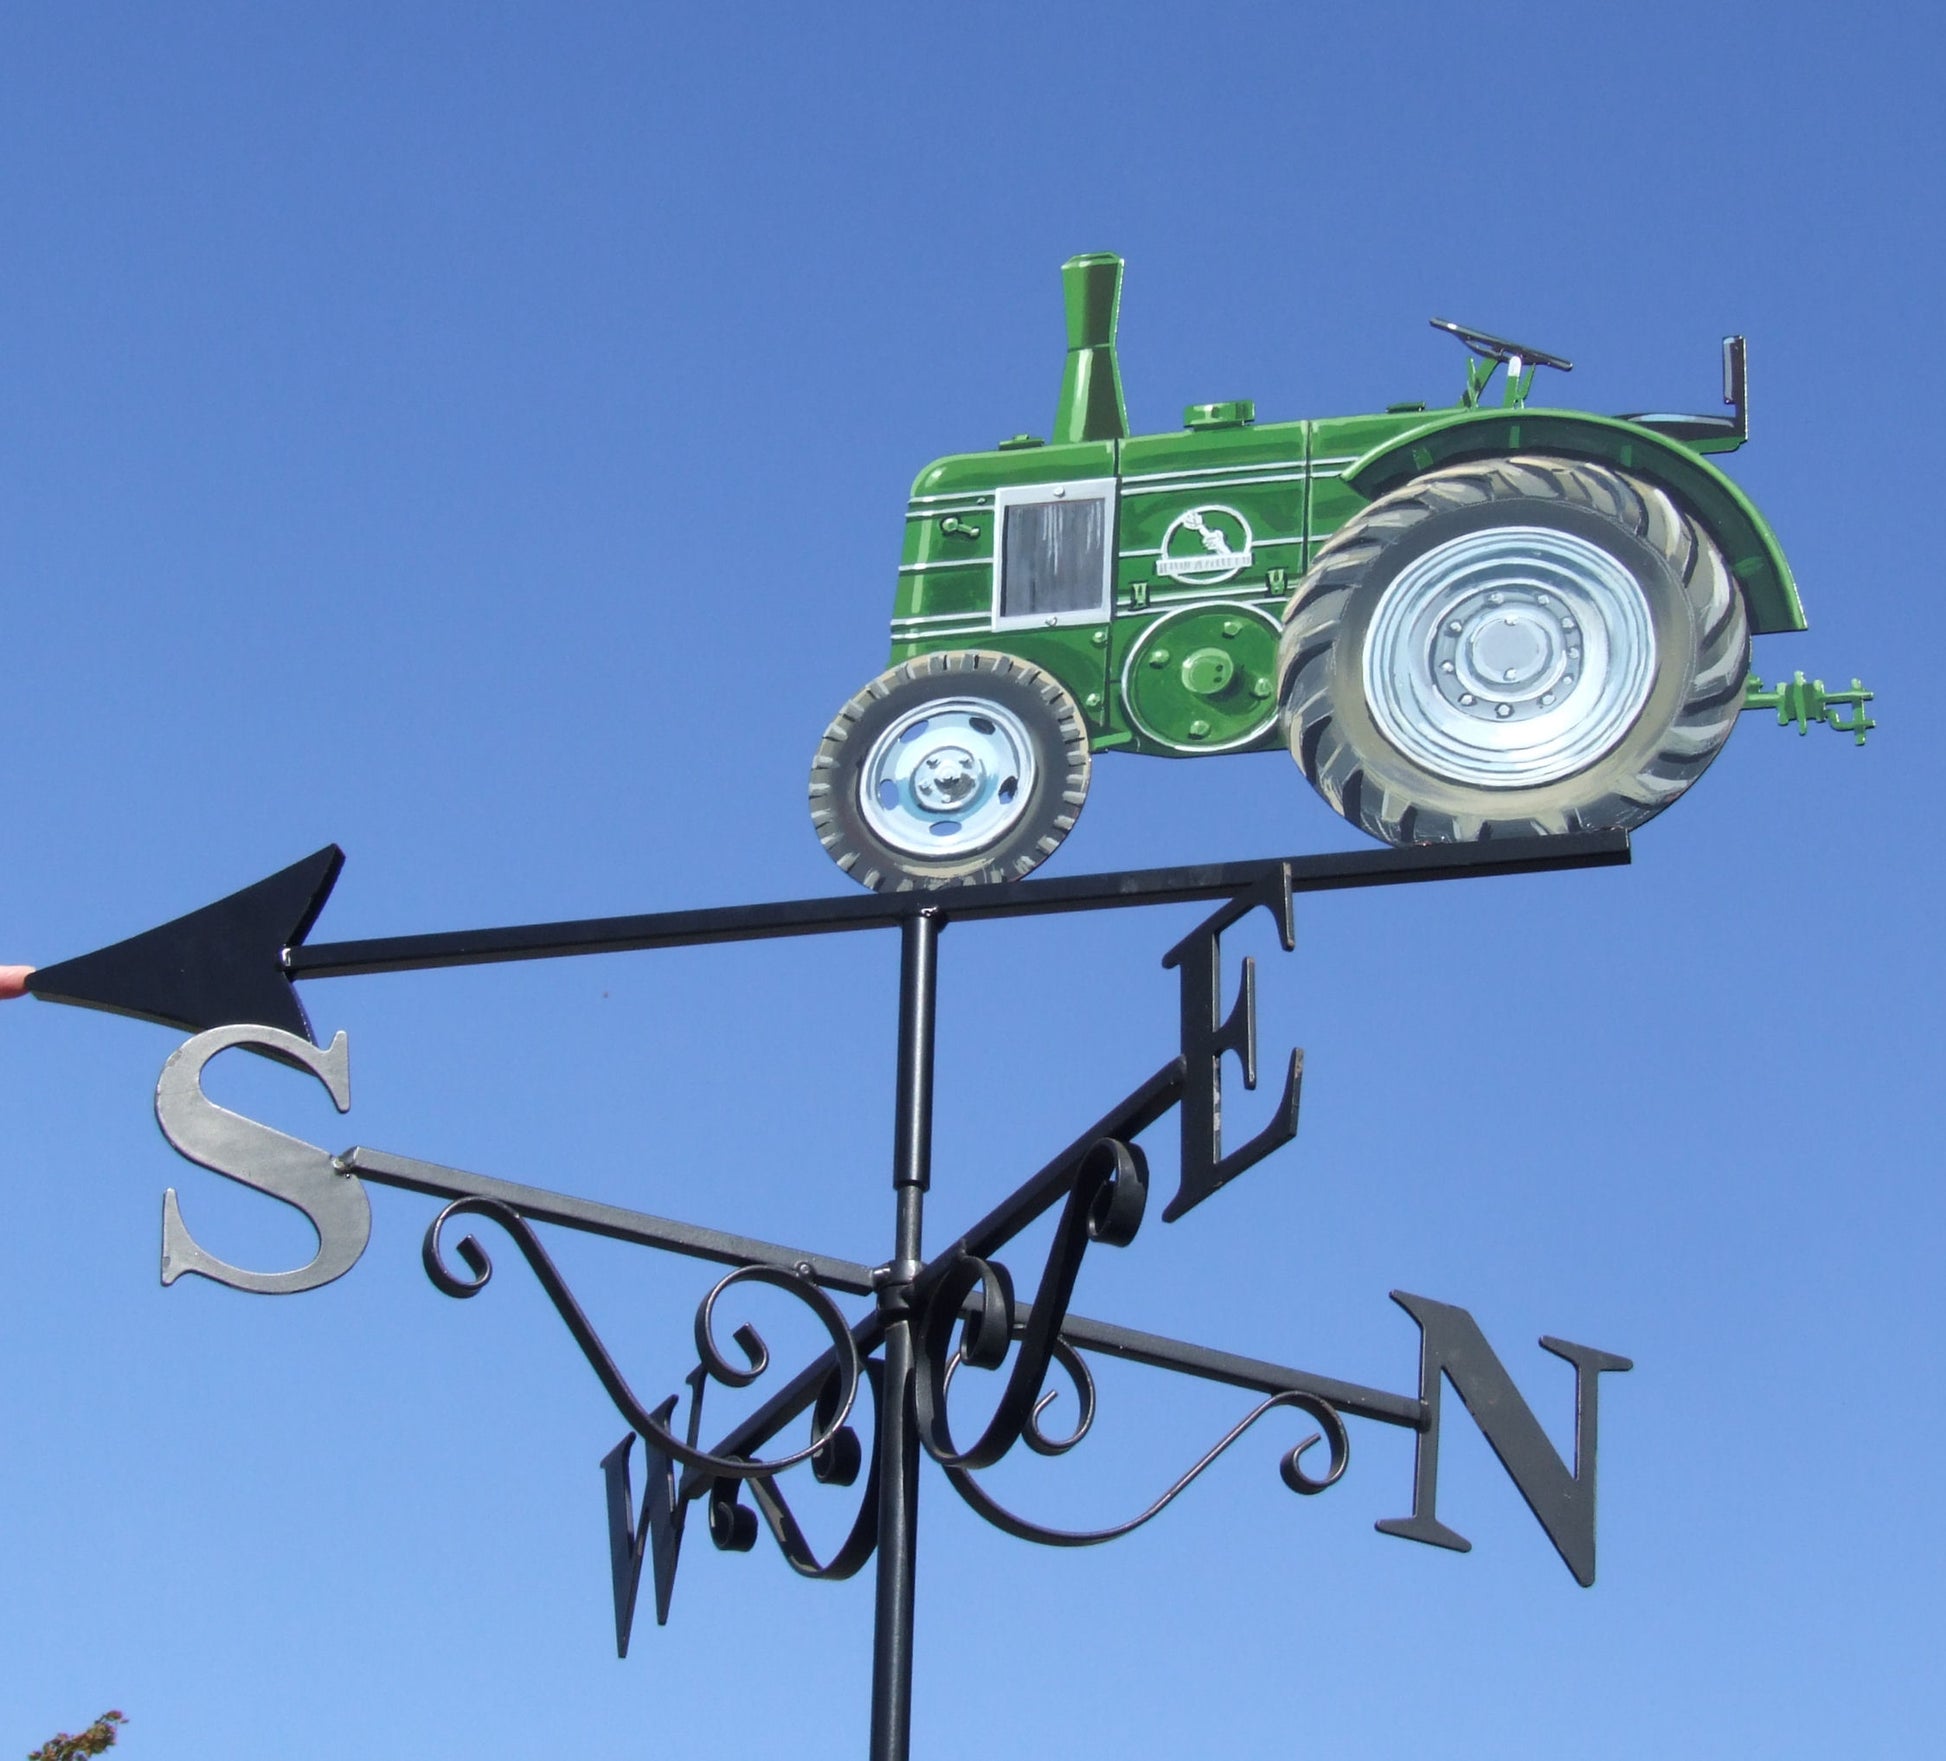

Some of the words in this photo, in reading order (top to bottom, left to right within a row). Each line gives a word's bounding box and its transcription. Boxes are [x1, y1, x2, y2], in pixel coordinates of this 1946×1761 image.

[155, 1024, 372, 1295] S
[1161, 862, 1303, 1222] E
[600, 1362, 709, 1659] W
[1375, 1289, 1634, 1587] N
